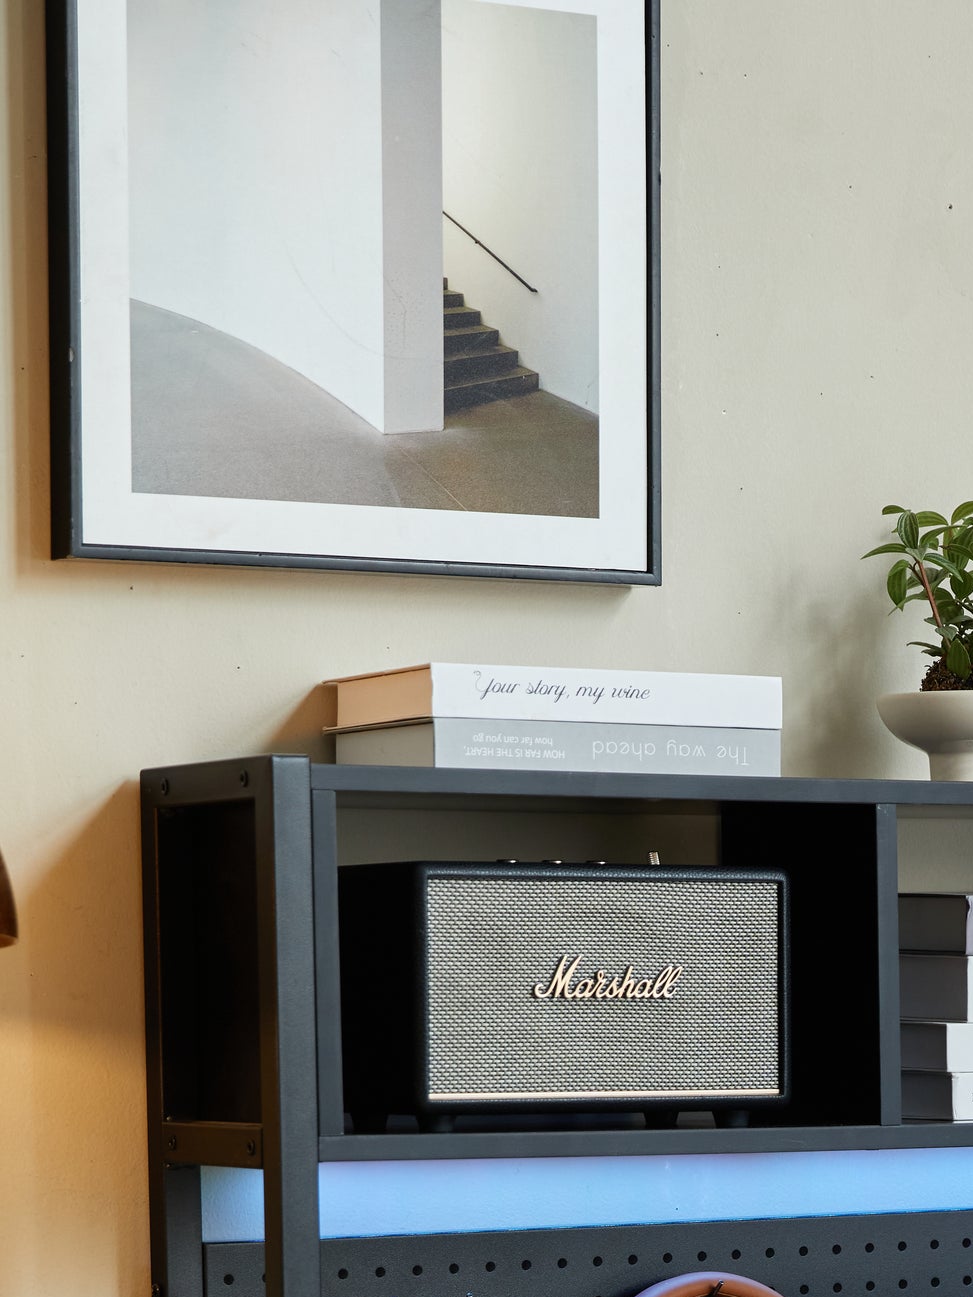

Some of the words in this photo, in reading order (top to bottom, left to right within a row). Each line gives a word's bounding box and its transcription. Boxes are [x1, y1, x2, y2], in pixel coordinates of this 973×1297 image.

[473, 670, 520, 700] Your
[576, 685, 605, 704] my
[612, 685, 651, 699] wine
[473, 732, 485, 742] go
[486, 733, 502, 743] you
[503, 735, 520, 743] can
[521, 736, 533, 745] far
[535, 737, 553, 746] how
[496, 747, 513, 757] THE
[515, 748, 523, 758] IS
[592, 740, 656, 761] ahead
[667, 739, 706, 757] way
[525, 749, 541, 758] FAR
[543, 750, 565, 759] HOW
[716, 745, 750, 766] The
[534, 954, 683, 998] Marshall
